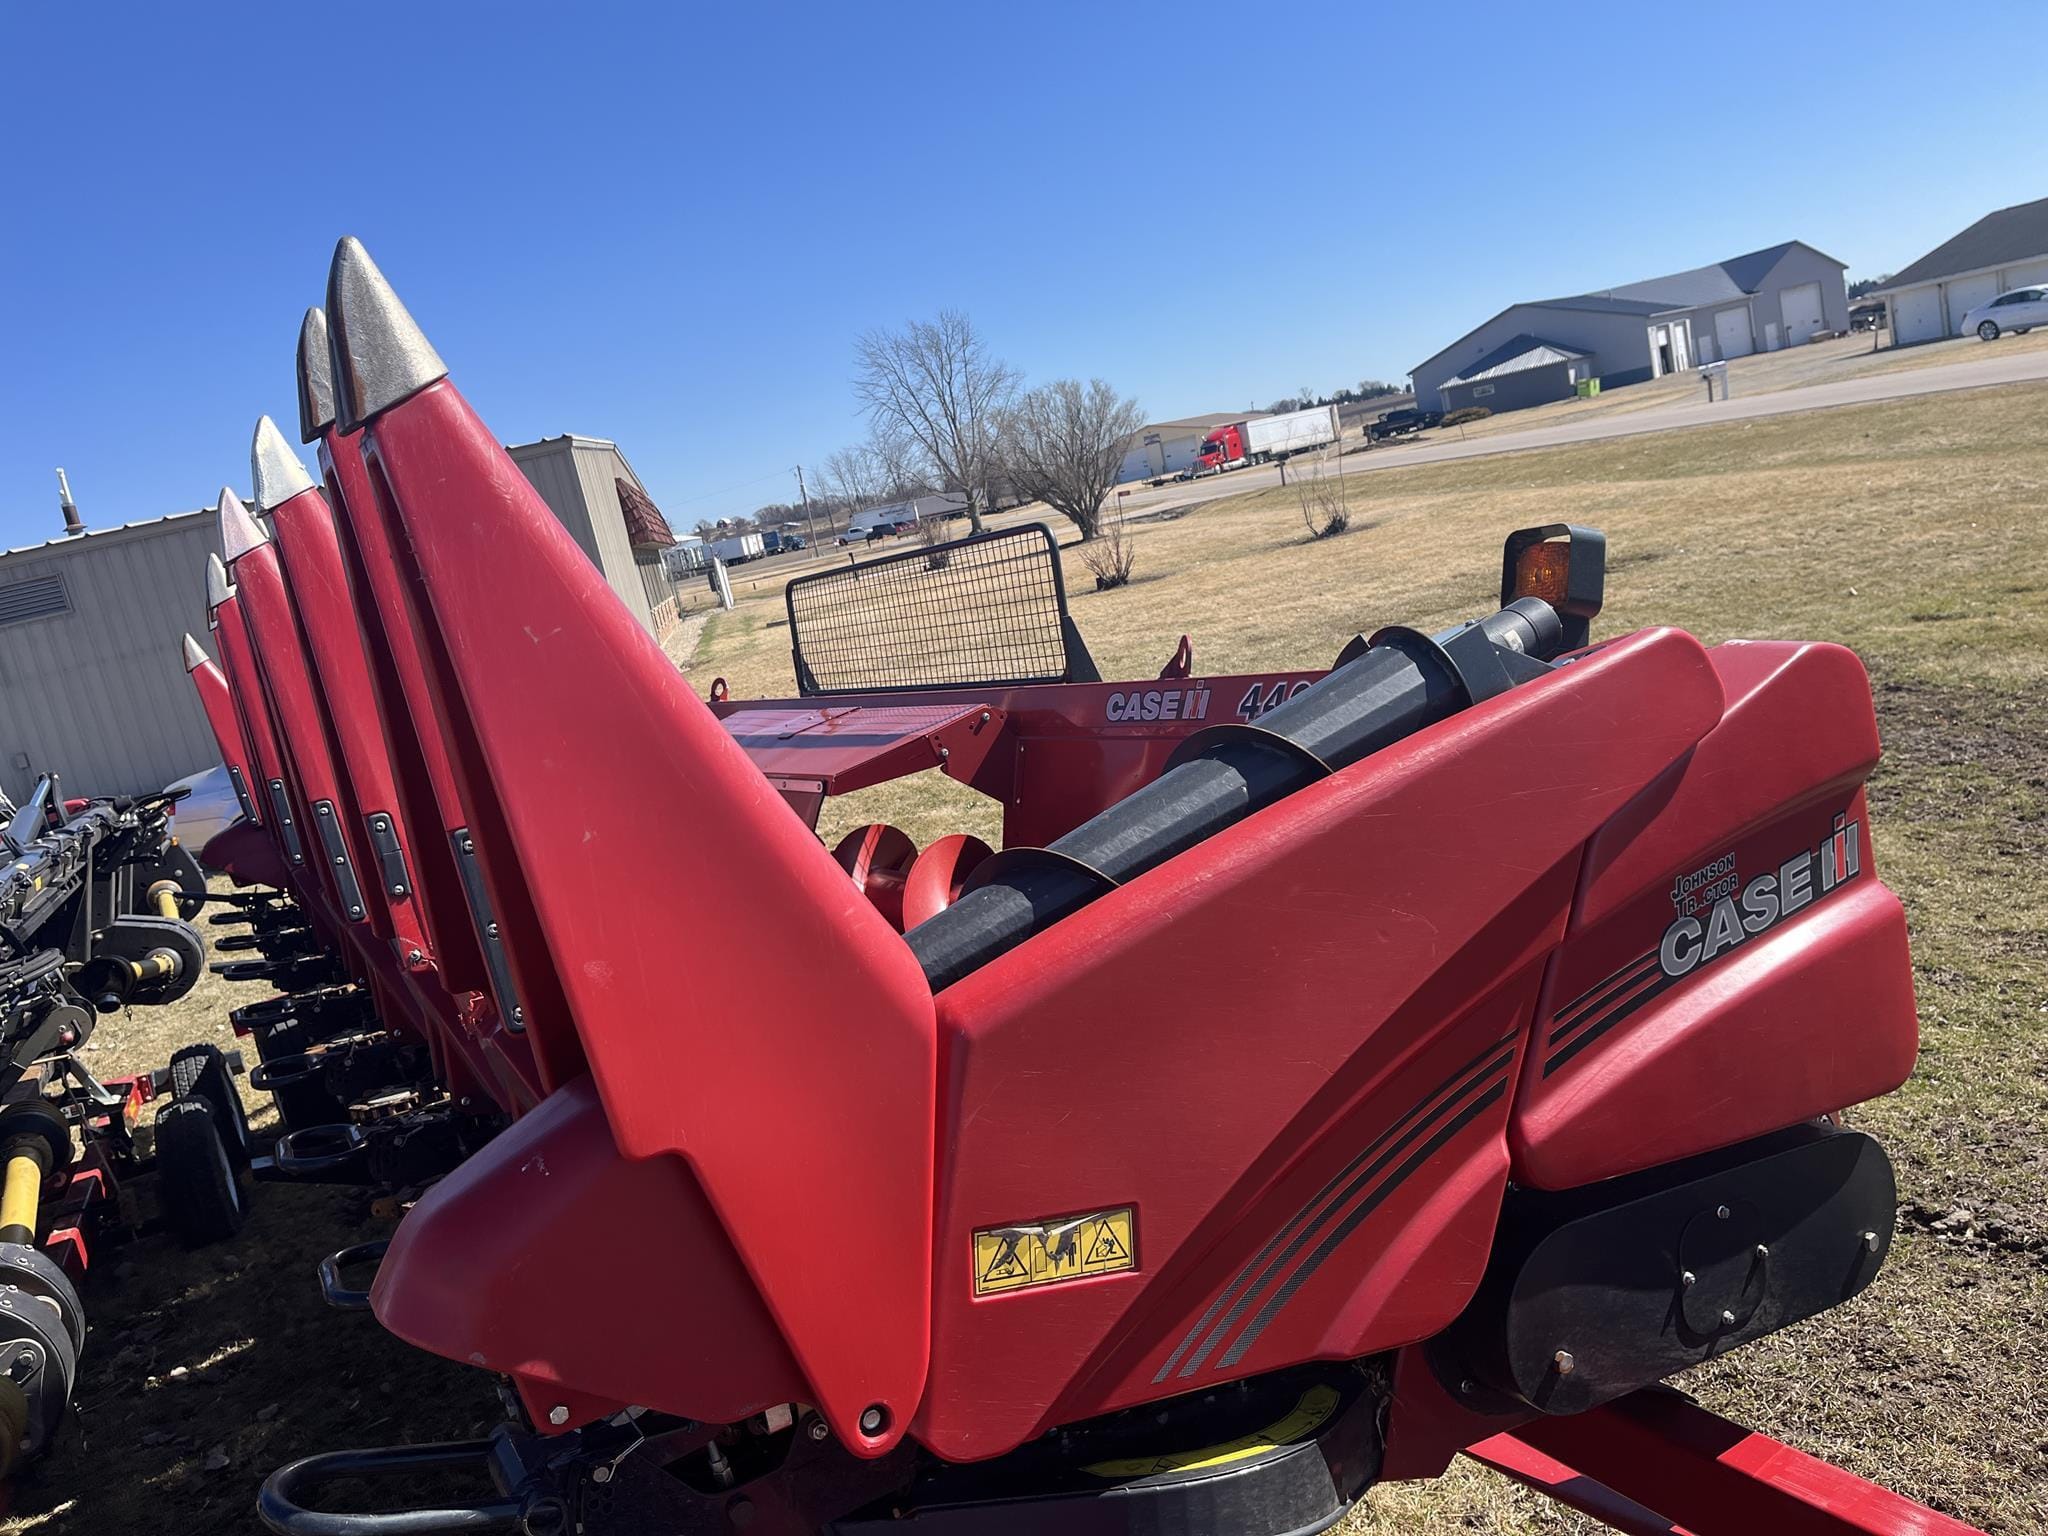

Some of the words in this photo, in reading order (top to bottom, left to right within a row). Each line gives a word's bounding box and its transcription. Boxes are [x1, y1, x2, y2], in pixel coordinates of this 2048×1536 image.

[1106, 691, 1181, 722] CASE
[1670, 851, 1735, 900] JOHNSON
[1674, 873, 1738, 919] TRCTOR
[1660, 851, 1813, 977] CASE
